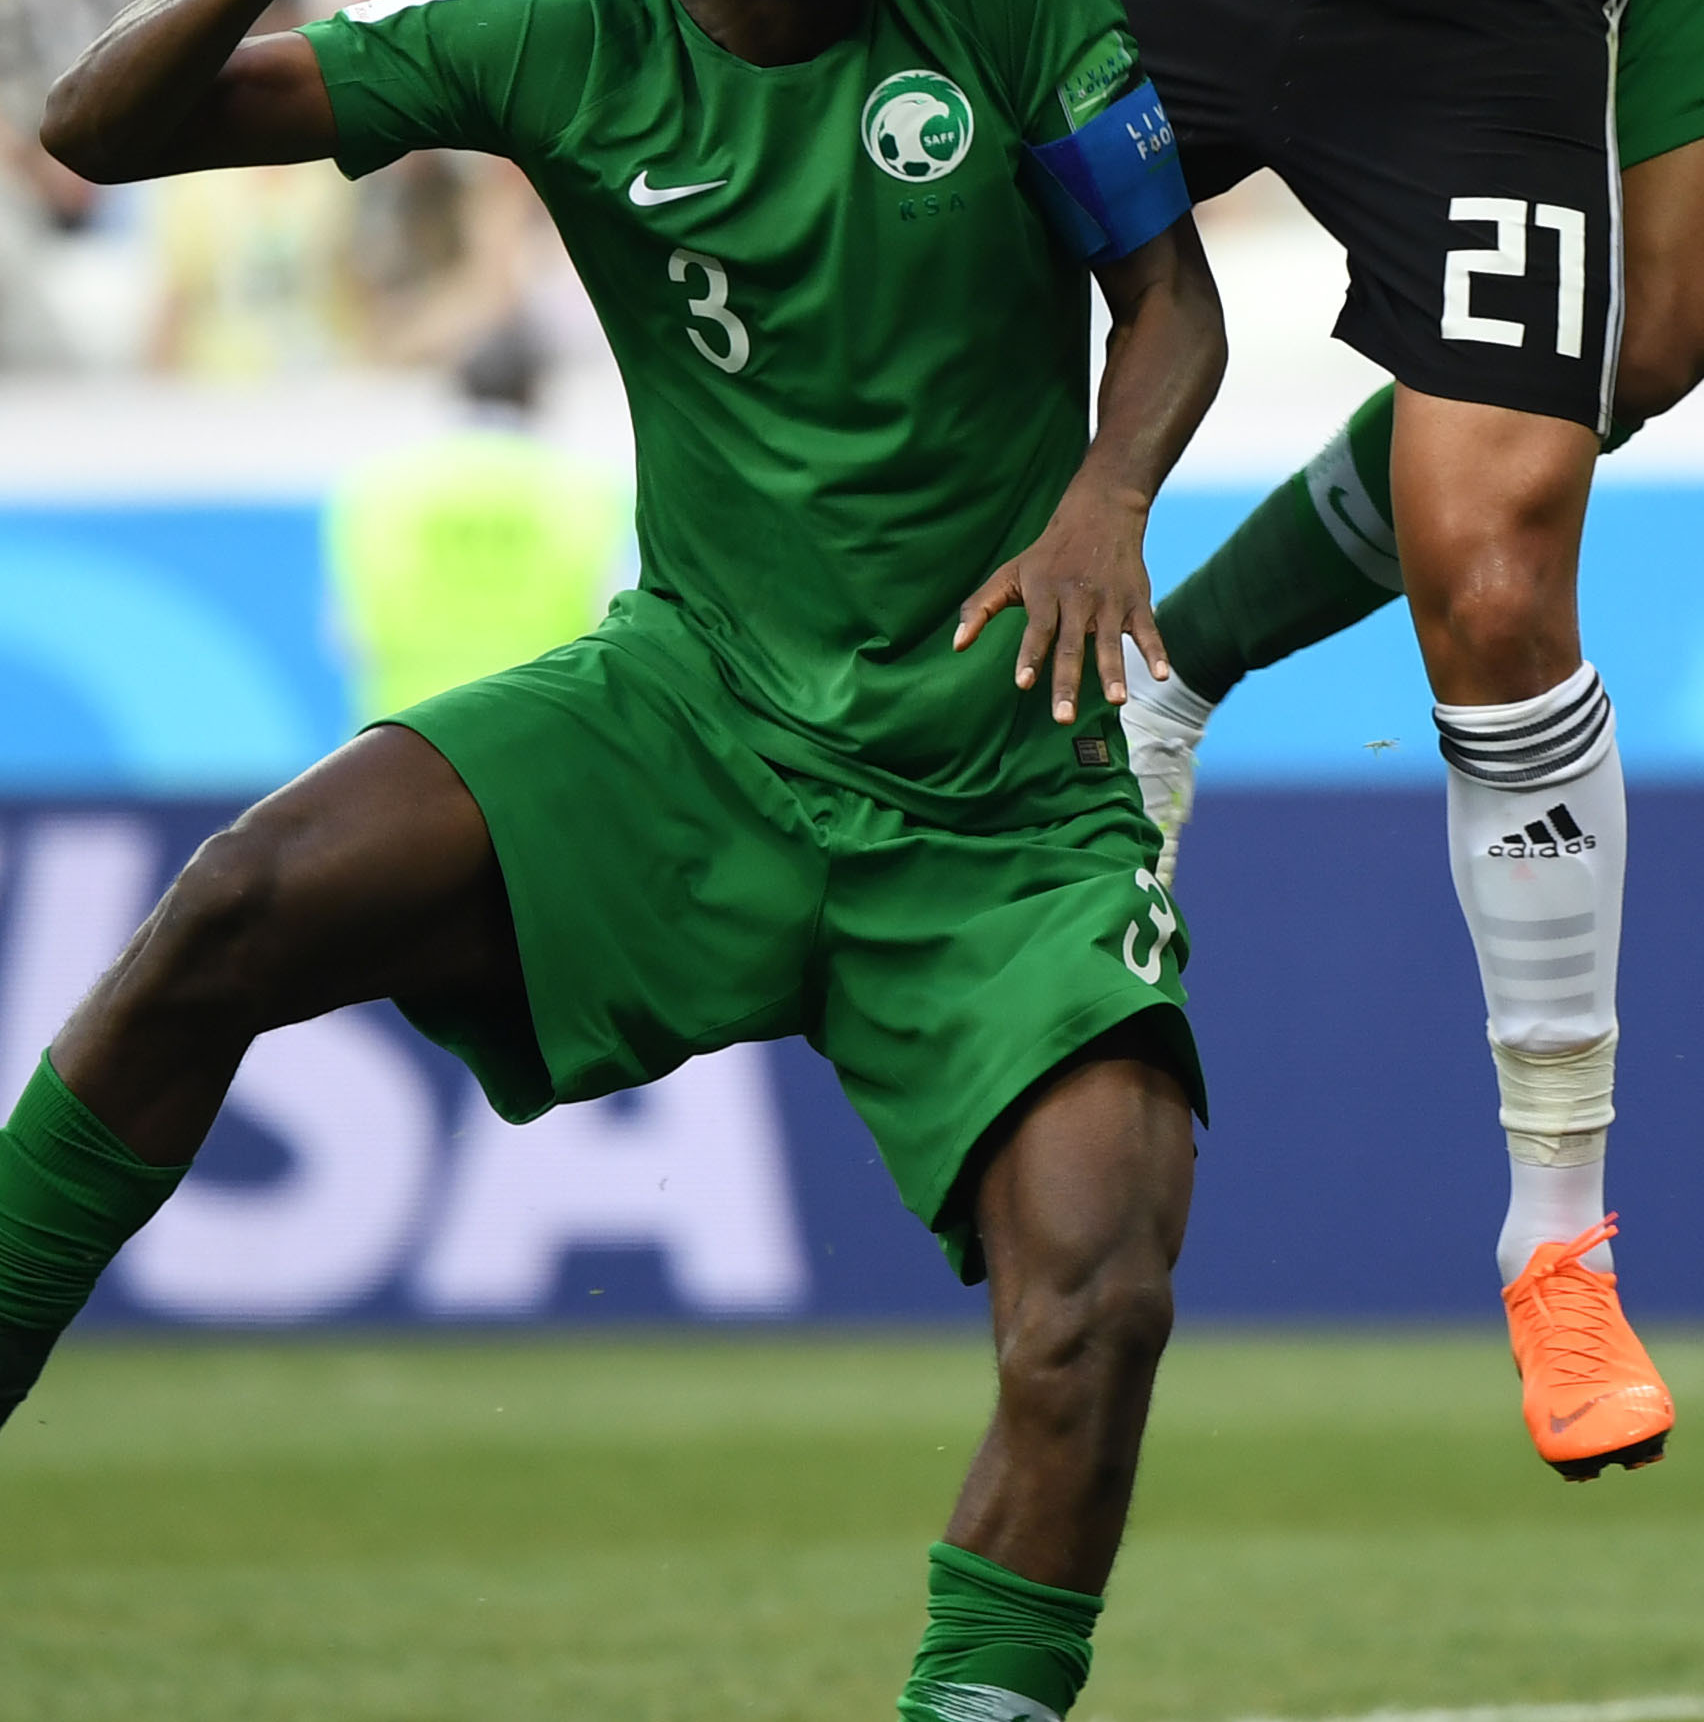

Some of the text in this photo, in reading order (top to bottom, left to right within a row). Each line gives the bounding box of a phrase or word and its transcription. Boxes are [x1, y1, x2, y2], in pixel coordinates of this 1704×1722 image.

[923, 131, 956, 148] SAFF
[667, 248, 750, 374] 3
[1440, 197, 1586, 359] 21
[1487, 833, 1597, 859] adidas
[1122, 867, 1177, 985] 3
